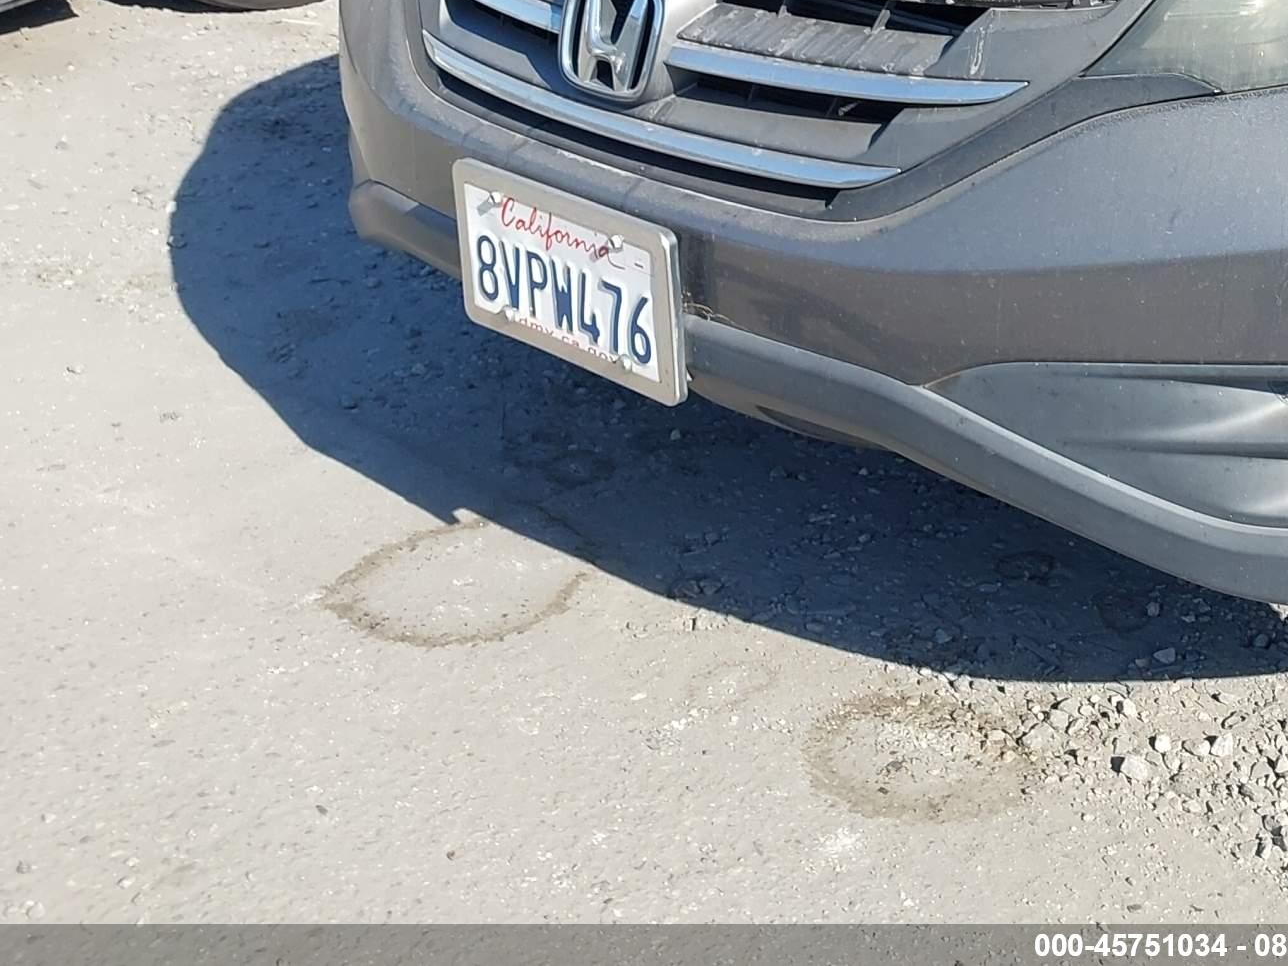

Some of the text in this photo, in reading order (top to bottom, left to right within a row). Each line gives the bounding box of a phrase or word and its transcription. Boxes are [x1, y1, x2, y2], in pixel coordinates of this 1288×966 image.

[500, 196, 625, 270] California
[476, 234, 652, 365] 8VPW476
[518, 317, 618, 364] dmvcagov
